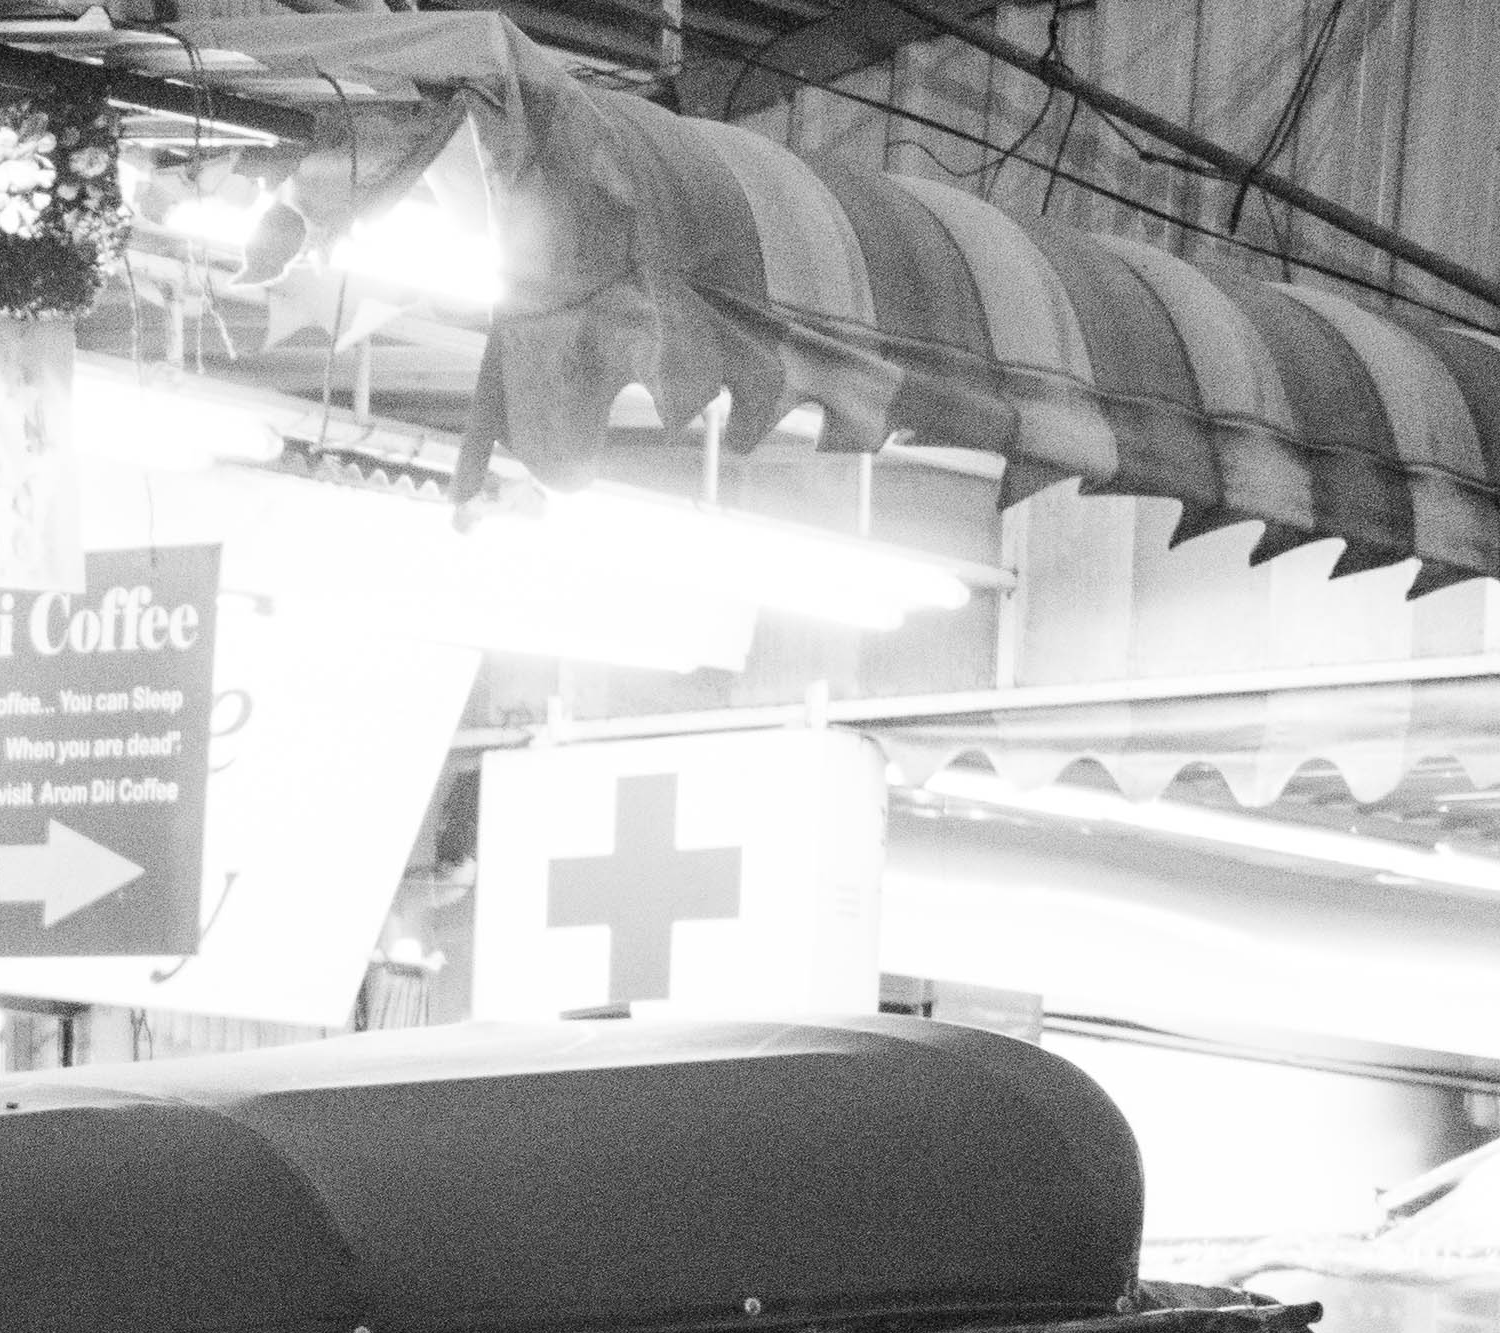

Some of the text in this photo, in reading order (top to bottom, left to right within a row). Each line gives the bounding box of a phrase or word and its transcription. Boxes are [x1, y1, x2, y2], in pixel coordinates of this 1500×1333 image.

[29, 584, 198, 656] Coffee
[58, 690, 93, 715] You
[96, 692, 129, 713] can
[131, 686, 184, 717] Sleep
[5, 735, 55, 762] When
[57, 740, 90, 767] you
[92, 739, 124, 758] are
[40, 780, 89, 806] Arom
[91, 780, 116, 803] Dii
[118, 778, 179, 804] Coffee
